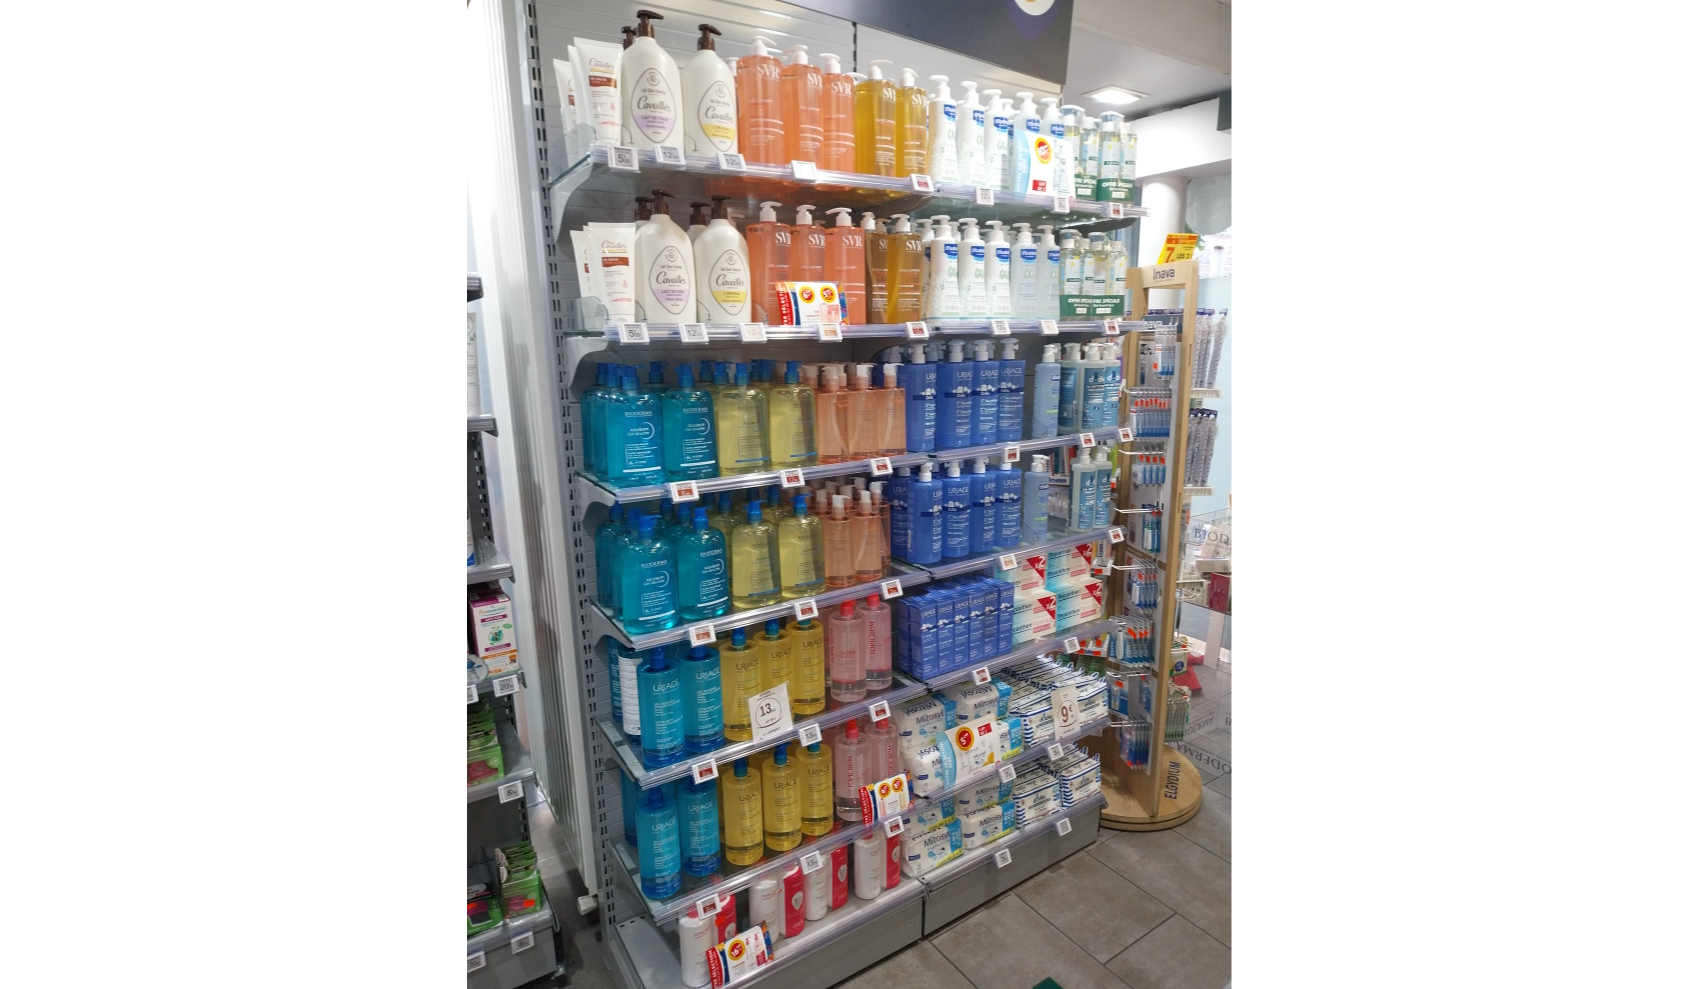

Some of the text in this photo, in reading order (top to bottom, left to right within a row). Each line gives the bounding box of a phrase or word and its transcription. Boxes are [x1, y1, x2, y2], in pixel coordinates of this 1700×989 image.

[757, 64, 780, 80] SVR
[831, 82, 852, 96] SVR
[842, 236, 862, 247] SVR
[879, 239, 887, 249] SV
[906, 240, 922, 251] SVR
[1153, 268, 1175, 280] Inava
[696, 667, 720, 680] URIAGE
[653, 679, 679, 692] URIAGE
[916, 710, 944, 724] Mitosyl
[917, 746, 939, 759] tosyl
[774, 779, 797, 789] URIAGE
[1164, 761, 1181, 800] ELGYDIUM
[688, 802, 713, 812] URIAGE
[652, 817, 676, 831] URIAGE
